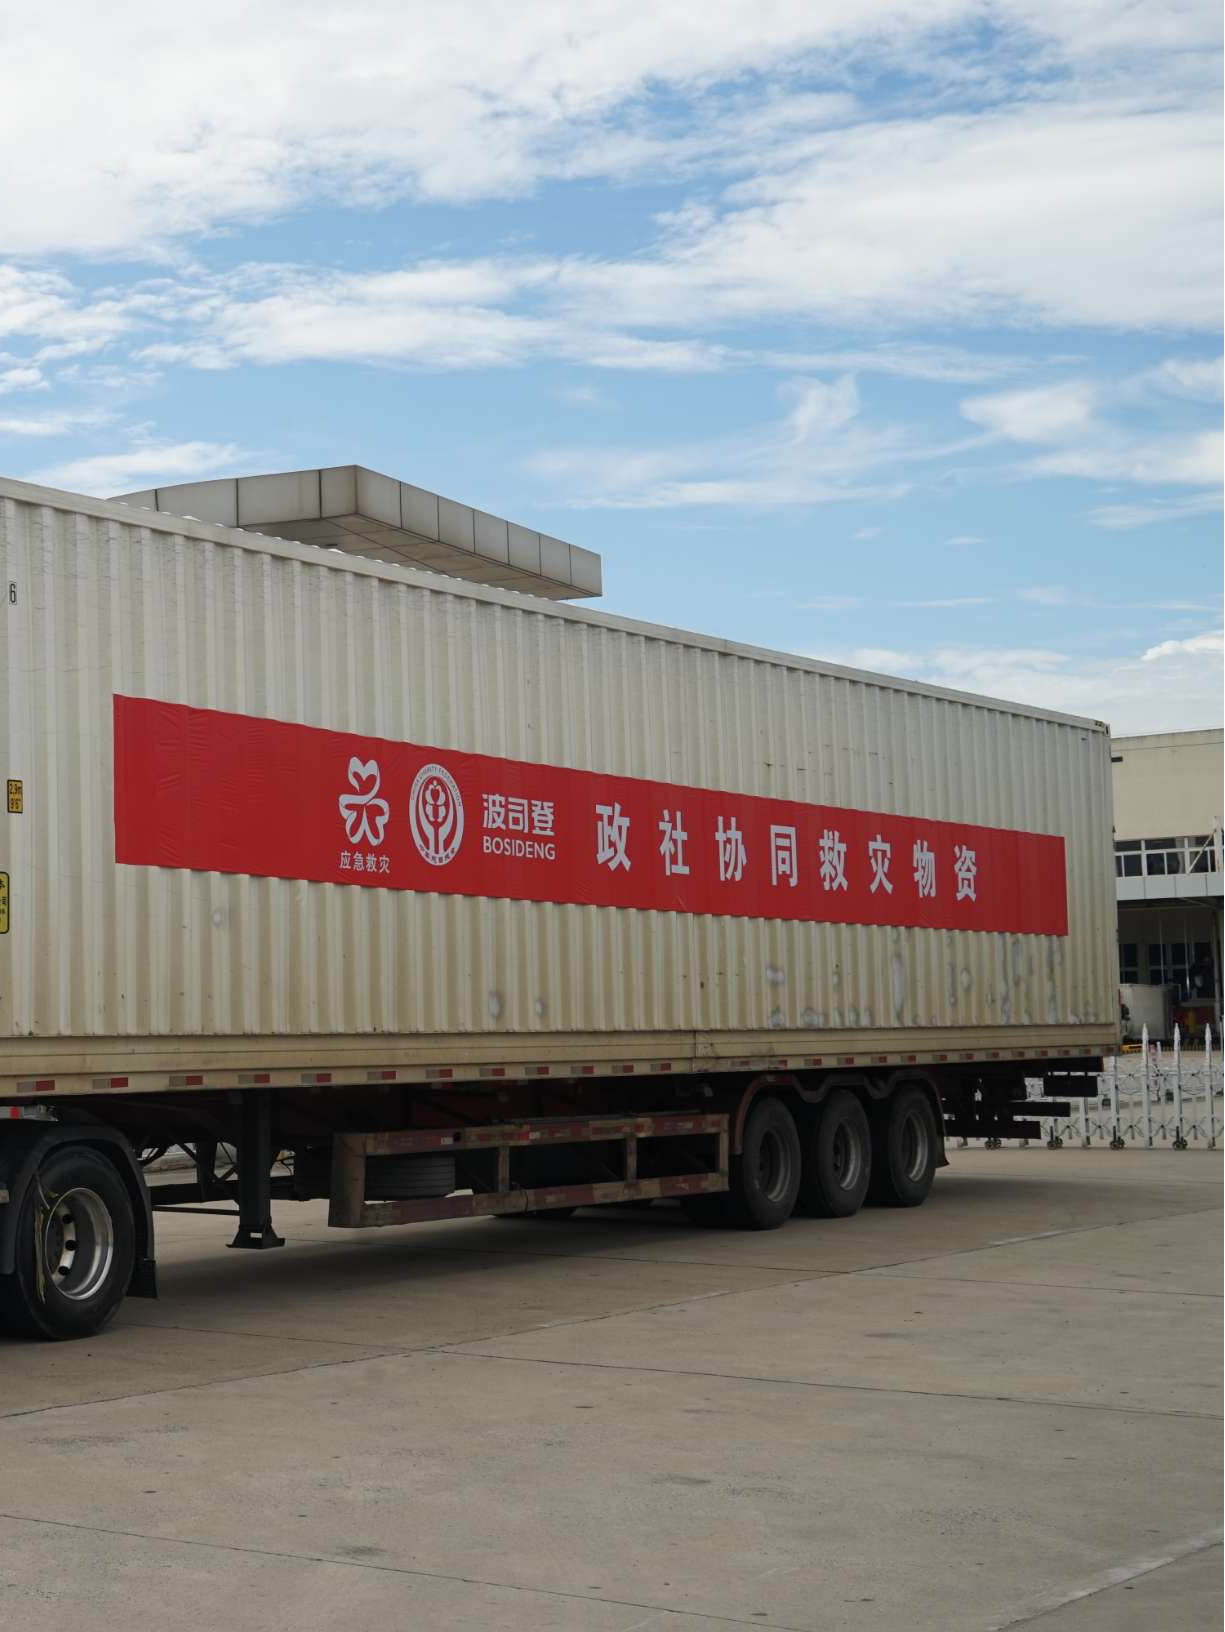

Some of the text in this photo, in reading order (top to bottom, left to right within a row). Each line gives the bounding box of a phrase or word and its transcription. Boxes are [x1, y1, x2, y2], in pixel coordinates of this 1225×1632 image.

[8, 581, 17, 604] 6
[482, 794, 555, 836] 波司登
[482, 835, 556, 860] BOSIDENG
[595, 802, 977, 902] 政社协同救灾物资
[339, 851, 391, 874] 应急救灾
